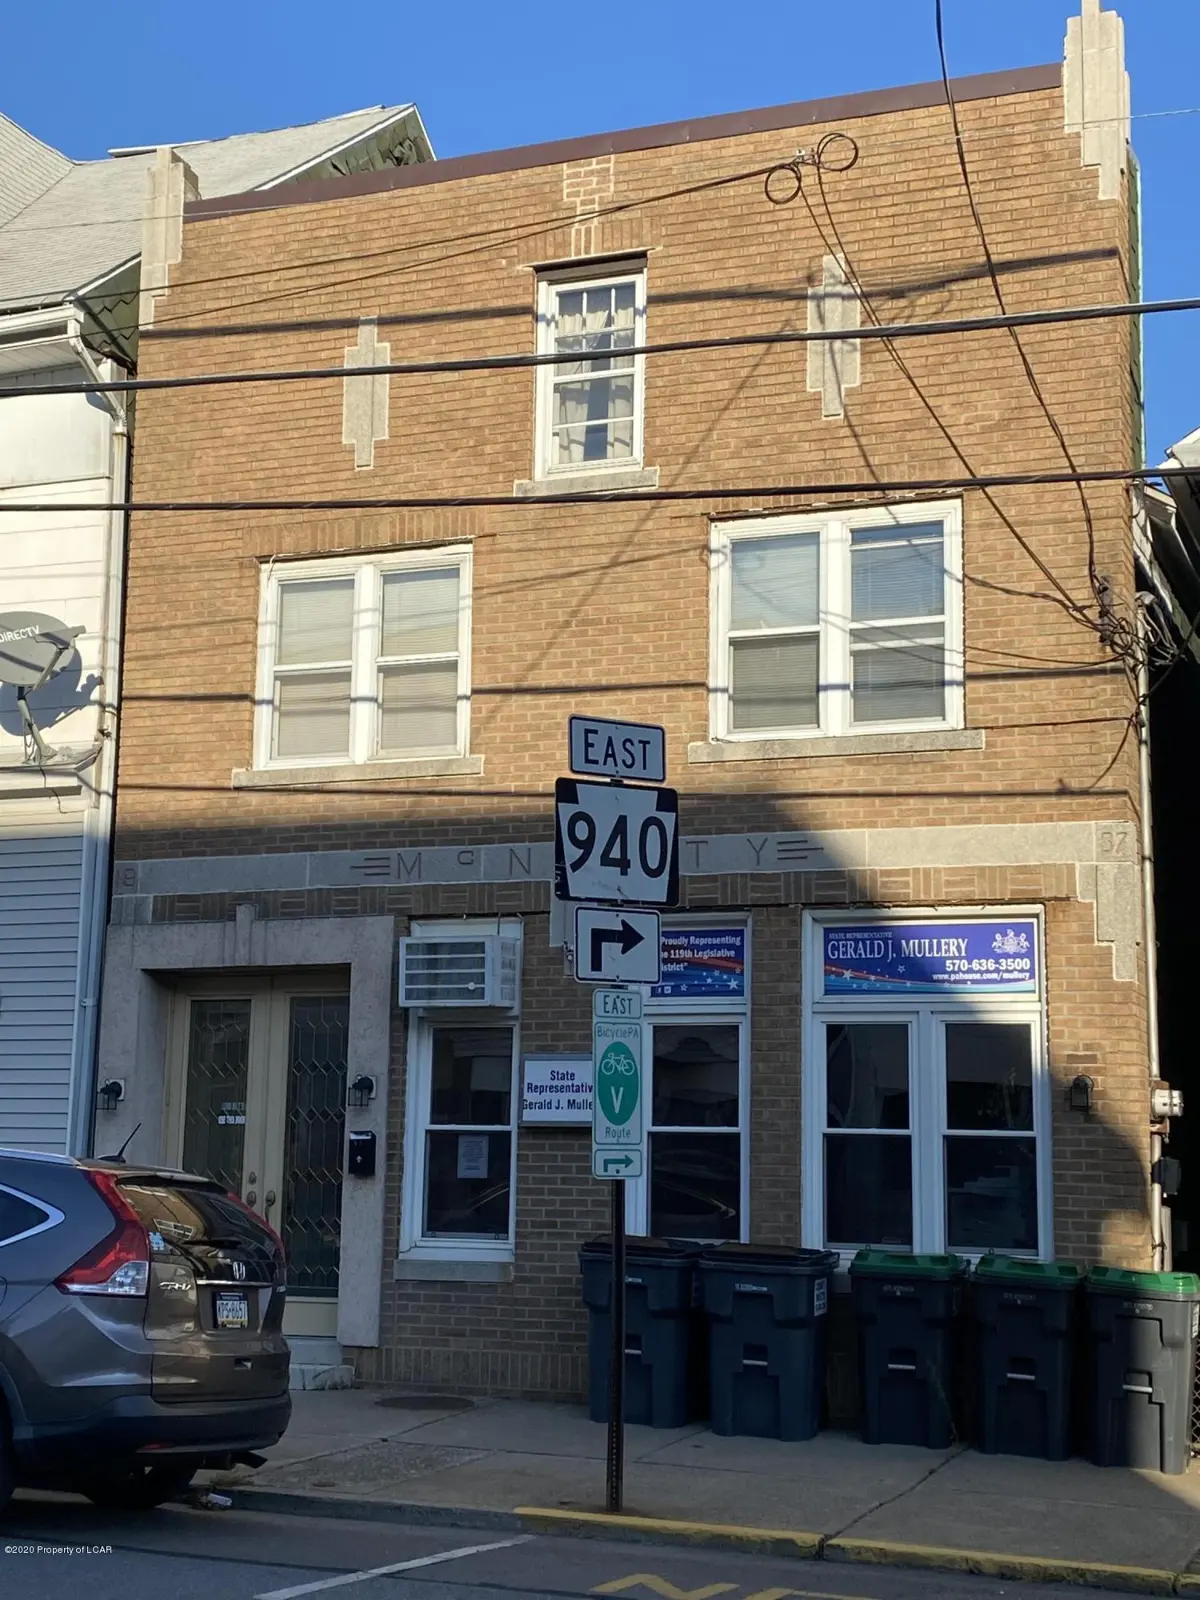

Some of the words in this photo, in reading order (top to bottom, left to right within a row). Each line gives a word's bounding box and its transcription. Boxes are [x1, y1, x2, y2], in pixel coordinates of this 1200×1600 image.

[0, 625, 40, 642] DIRECTV
[584, 728, 651, 770] EAST
[567, 811, 668, 878] 940
[690, 935, 741, 946] Representing
[670, 949, 692, 958] 119th
[694, 948, 735, 959] Legislative
[828, 940, 884, 959] GERALD
[887, 940, 897, 962] J.
[901, 938, 968, 958] MULLERY
[945, 958, 1031, 972] 570-636-3500
[603, 995, 633, 1014] EAST
[550, 1070, 575, 1081] State
[527, 1082, 593, 1095] Representativ
[522, 1099, 552, 1110] Gerald
[555, 1099, 564, 1110] J.
[567, 1099, 593, 1110] Mulle
[610, 1086, 624, 1114] V
[605, 1127, 632, 1139] Route
